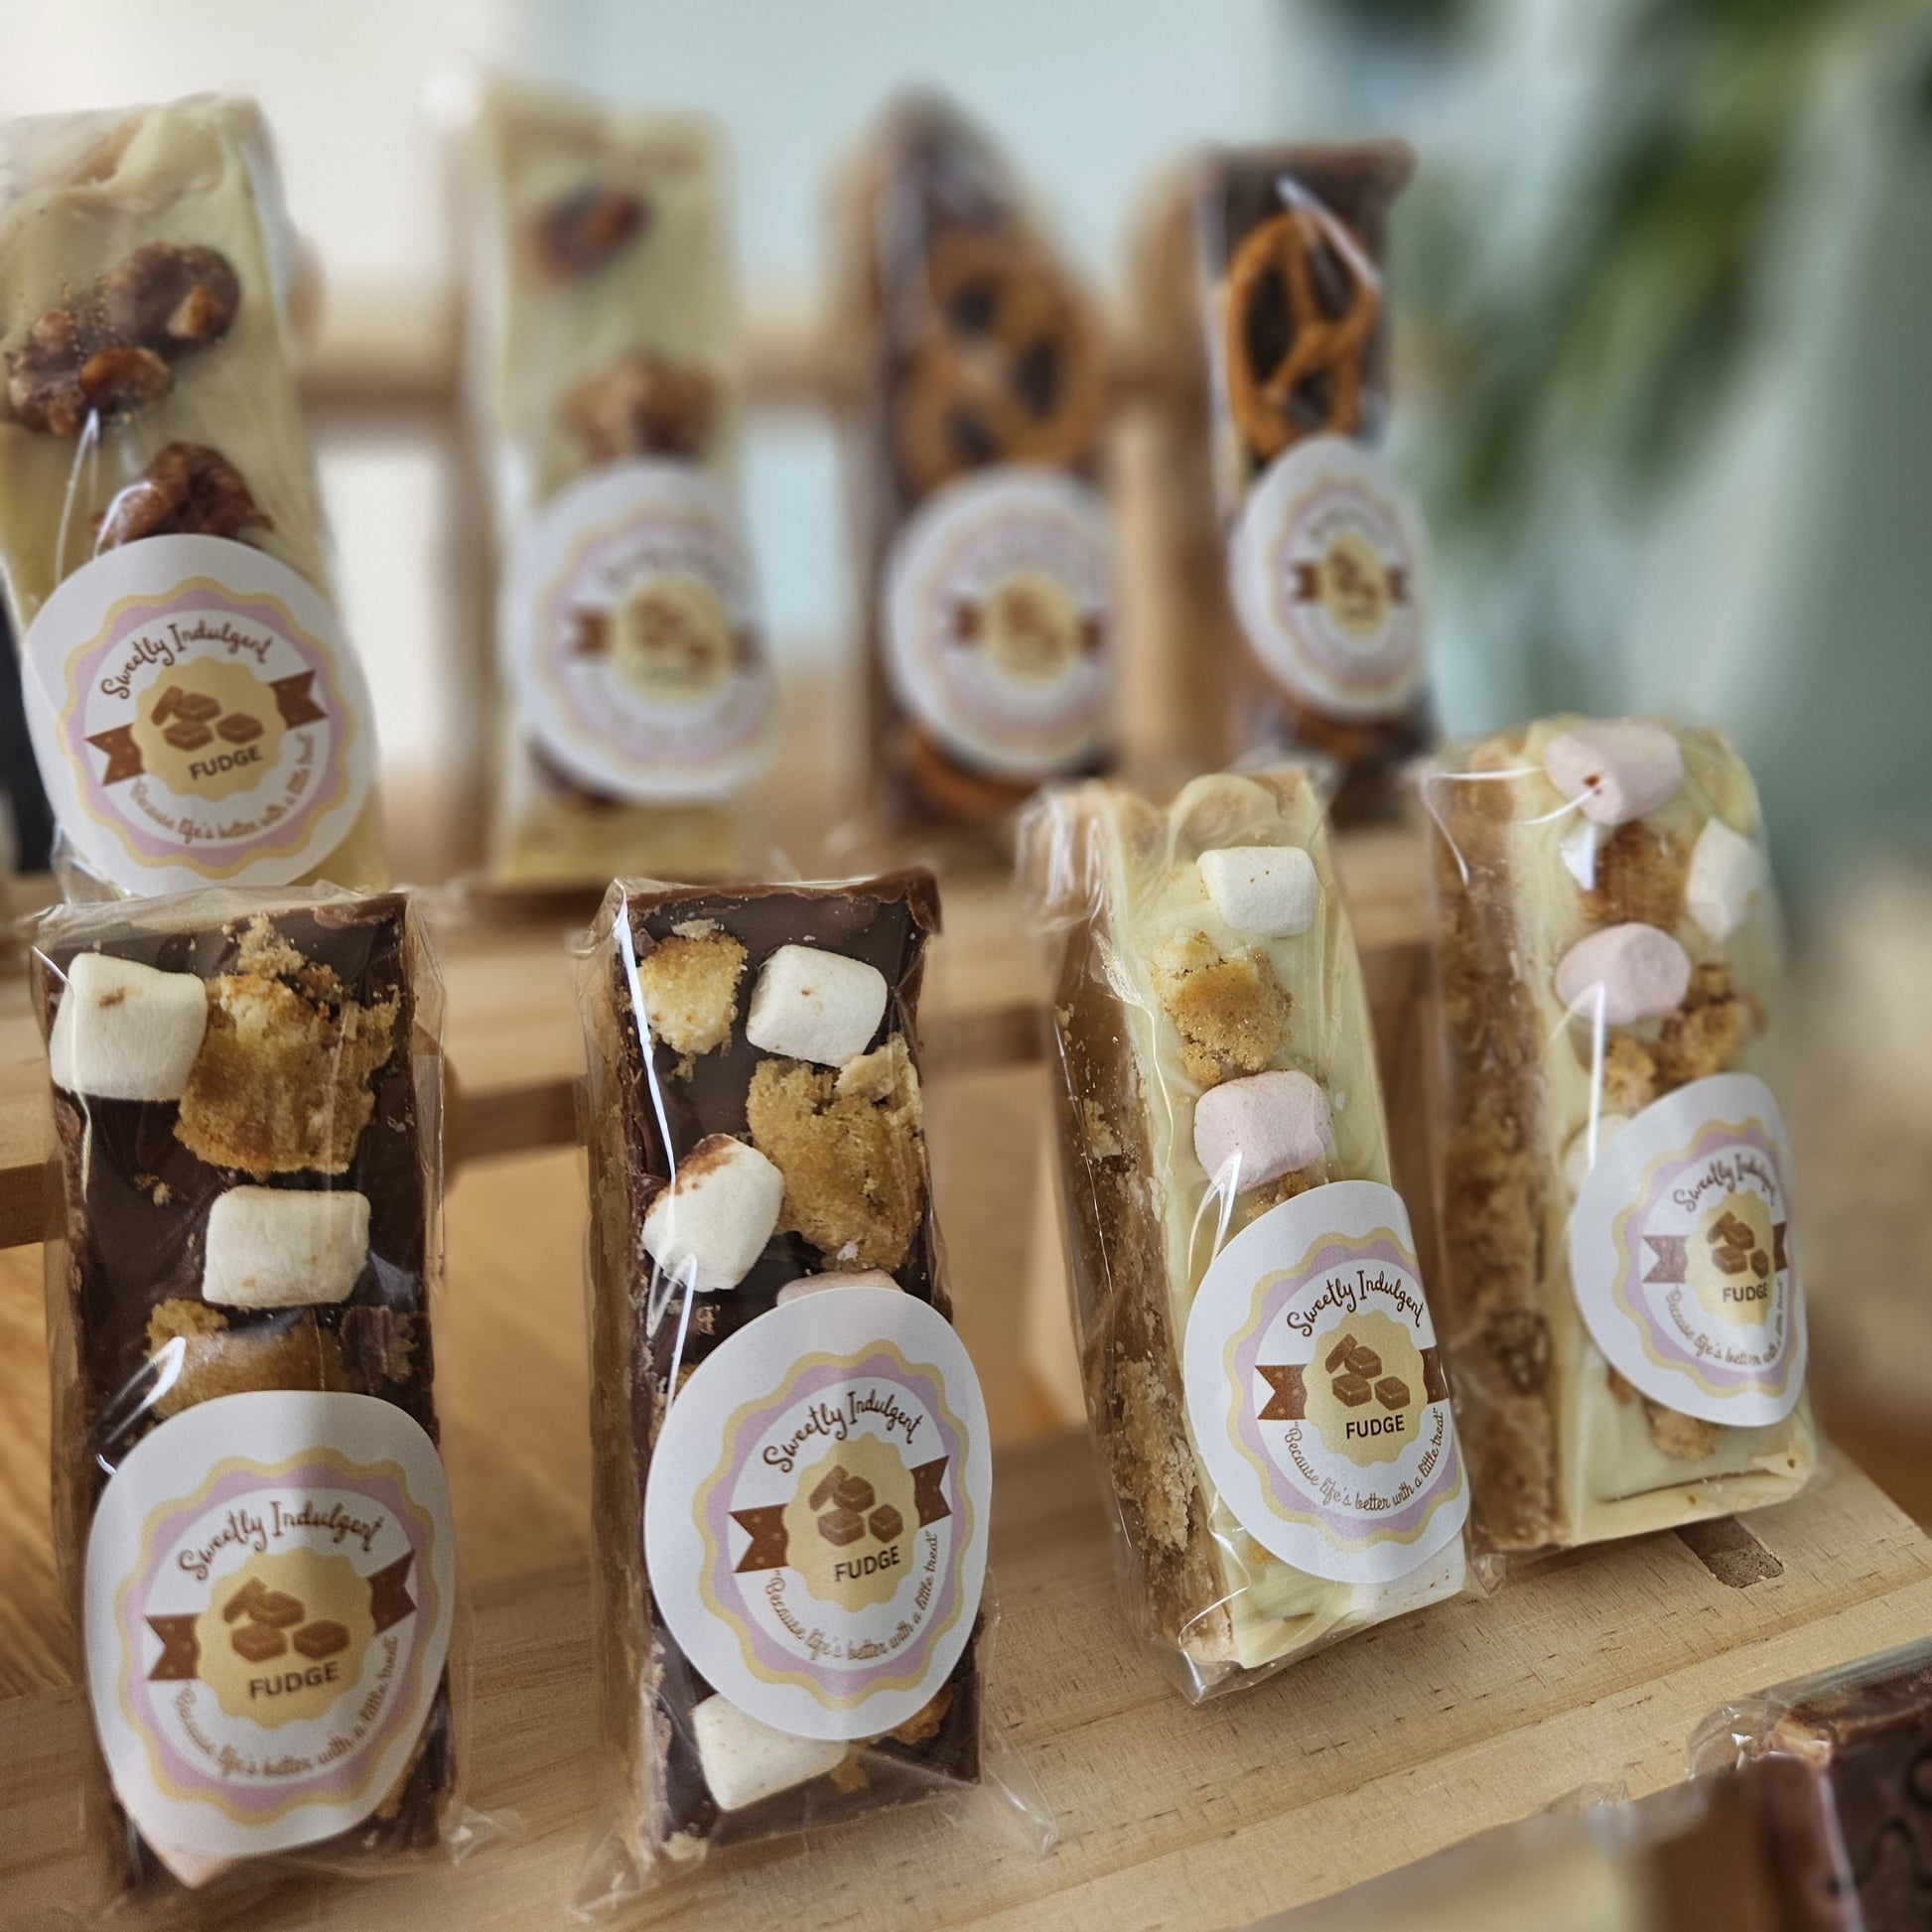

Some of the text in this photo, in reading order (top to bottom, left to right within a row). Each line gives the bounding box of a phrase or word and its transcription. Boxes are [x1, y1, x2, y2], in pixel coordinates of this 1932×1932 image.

[101, 620, 272, 700] Sweetly Indulgent
[189, 745, 262, 780] FUDGE
[1673, 1160, 1735, 1212] Sweetly
[1287, 1270, 1424, 1337] Sweetly Indulgent
[762, 1389, 923, 1473] Sweetly Indulgent
[1346, 1415, 1405, 1439] FUDGE
[1418, 1449, 1440, 1477] little
[1320, 1477, 1351, 1506] life's
[1392, 1481, 1414, 1506] with
[1415, 1477, 1423, 1487] a
[1355, 1491, 1391, 1511] better
[178, 1500, 384, 1581] Sweetly Indulgent
[834, 1545, 900, 1582] FUDGE
[249, 1660, 340, 1700] FUDGE
